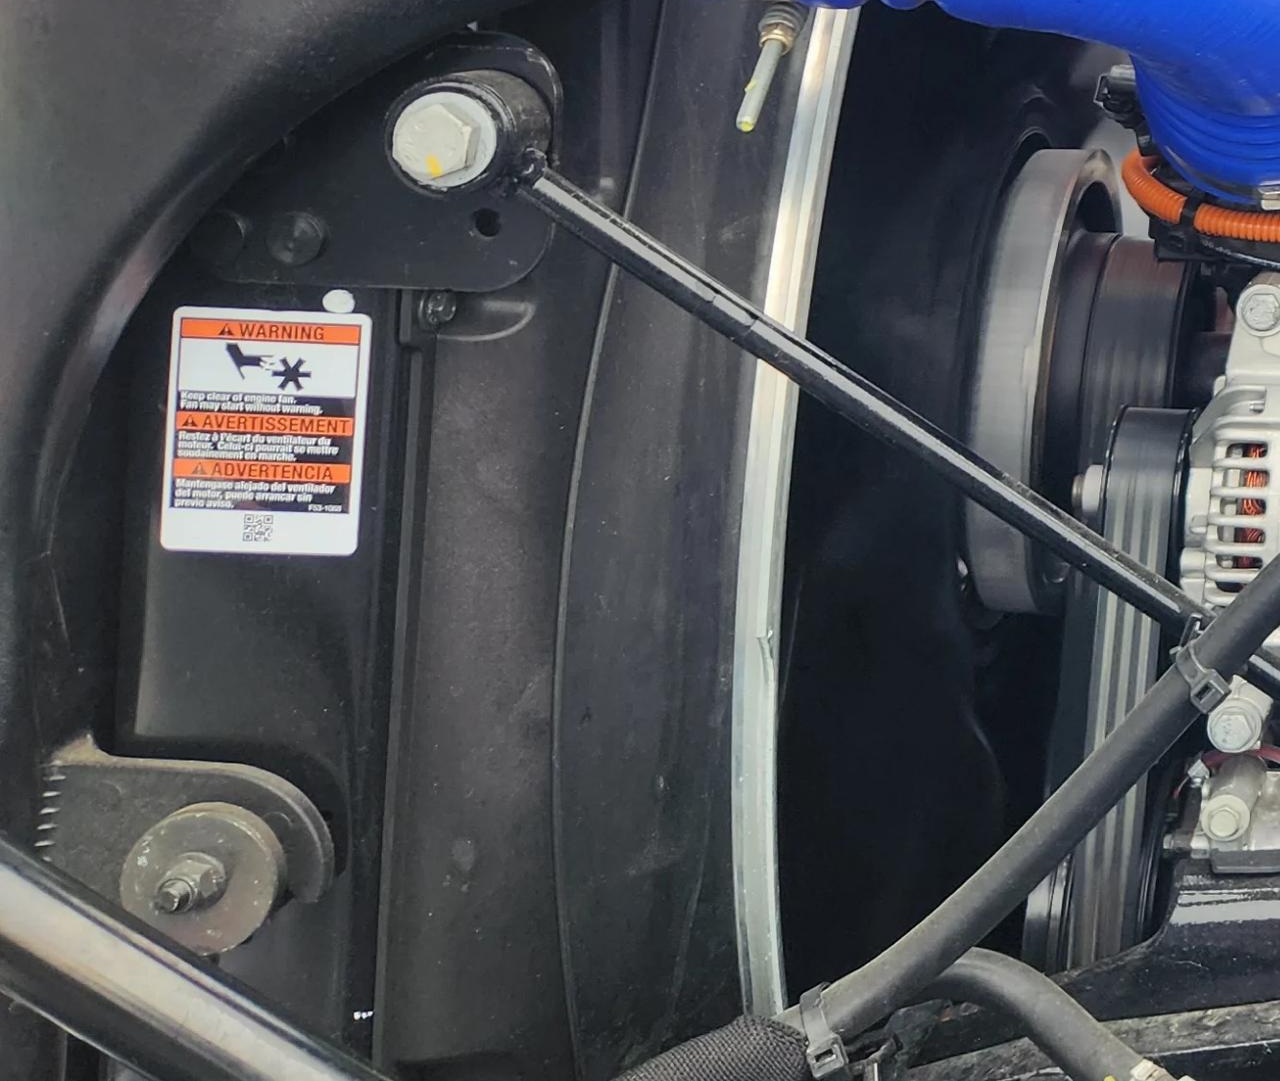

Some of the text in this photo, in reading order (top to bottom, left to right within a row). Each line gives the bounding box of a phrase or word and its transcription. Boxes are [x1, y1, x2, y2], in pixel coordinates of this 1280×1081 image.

[239, 323, 325, 341] WARNING
[180, 390, 297, 405] Keep clear of engine fan.
[180, 399, 323, 415] Fan may start without warning.
[202, 415, 349, 434] AVERTISSEMENT
[179, 431, 210, 441] Restez
[266, 434, 317, 446] ventilateur
[318, 436, 332, 446] du
[177, 449, 297, 463] soudainement en marche.
[178, 440, 214, 450] moteur.
[217, 441, 254, 452] Celui-ci
[255, 443, 292, 454] pourrait
[306, 445, 339, 456] mettre
[211, 462, 333, 481] ADVERTENCIA
[175, 478, 336, 495] Mantengase alejado del ventilador
[175, 487, 313, 503] del motor, puede arrancar sin
[174, 498, 206, 509] previo
[206, 499, 235, 509] aviso.
